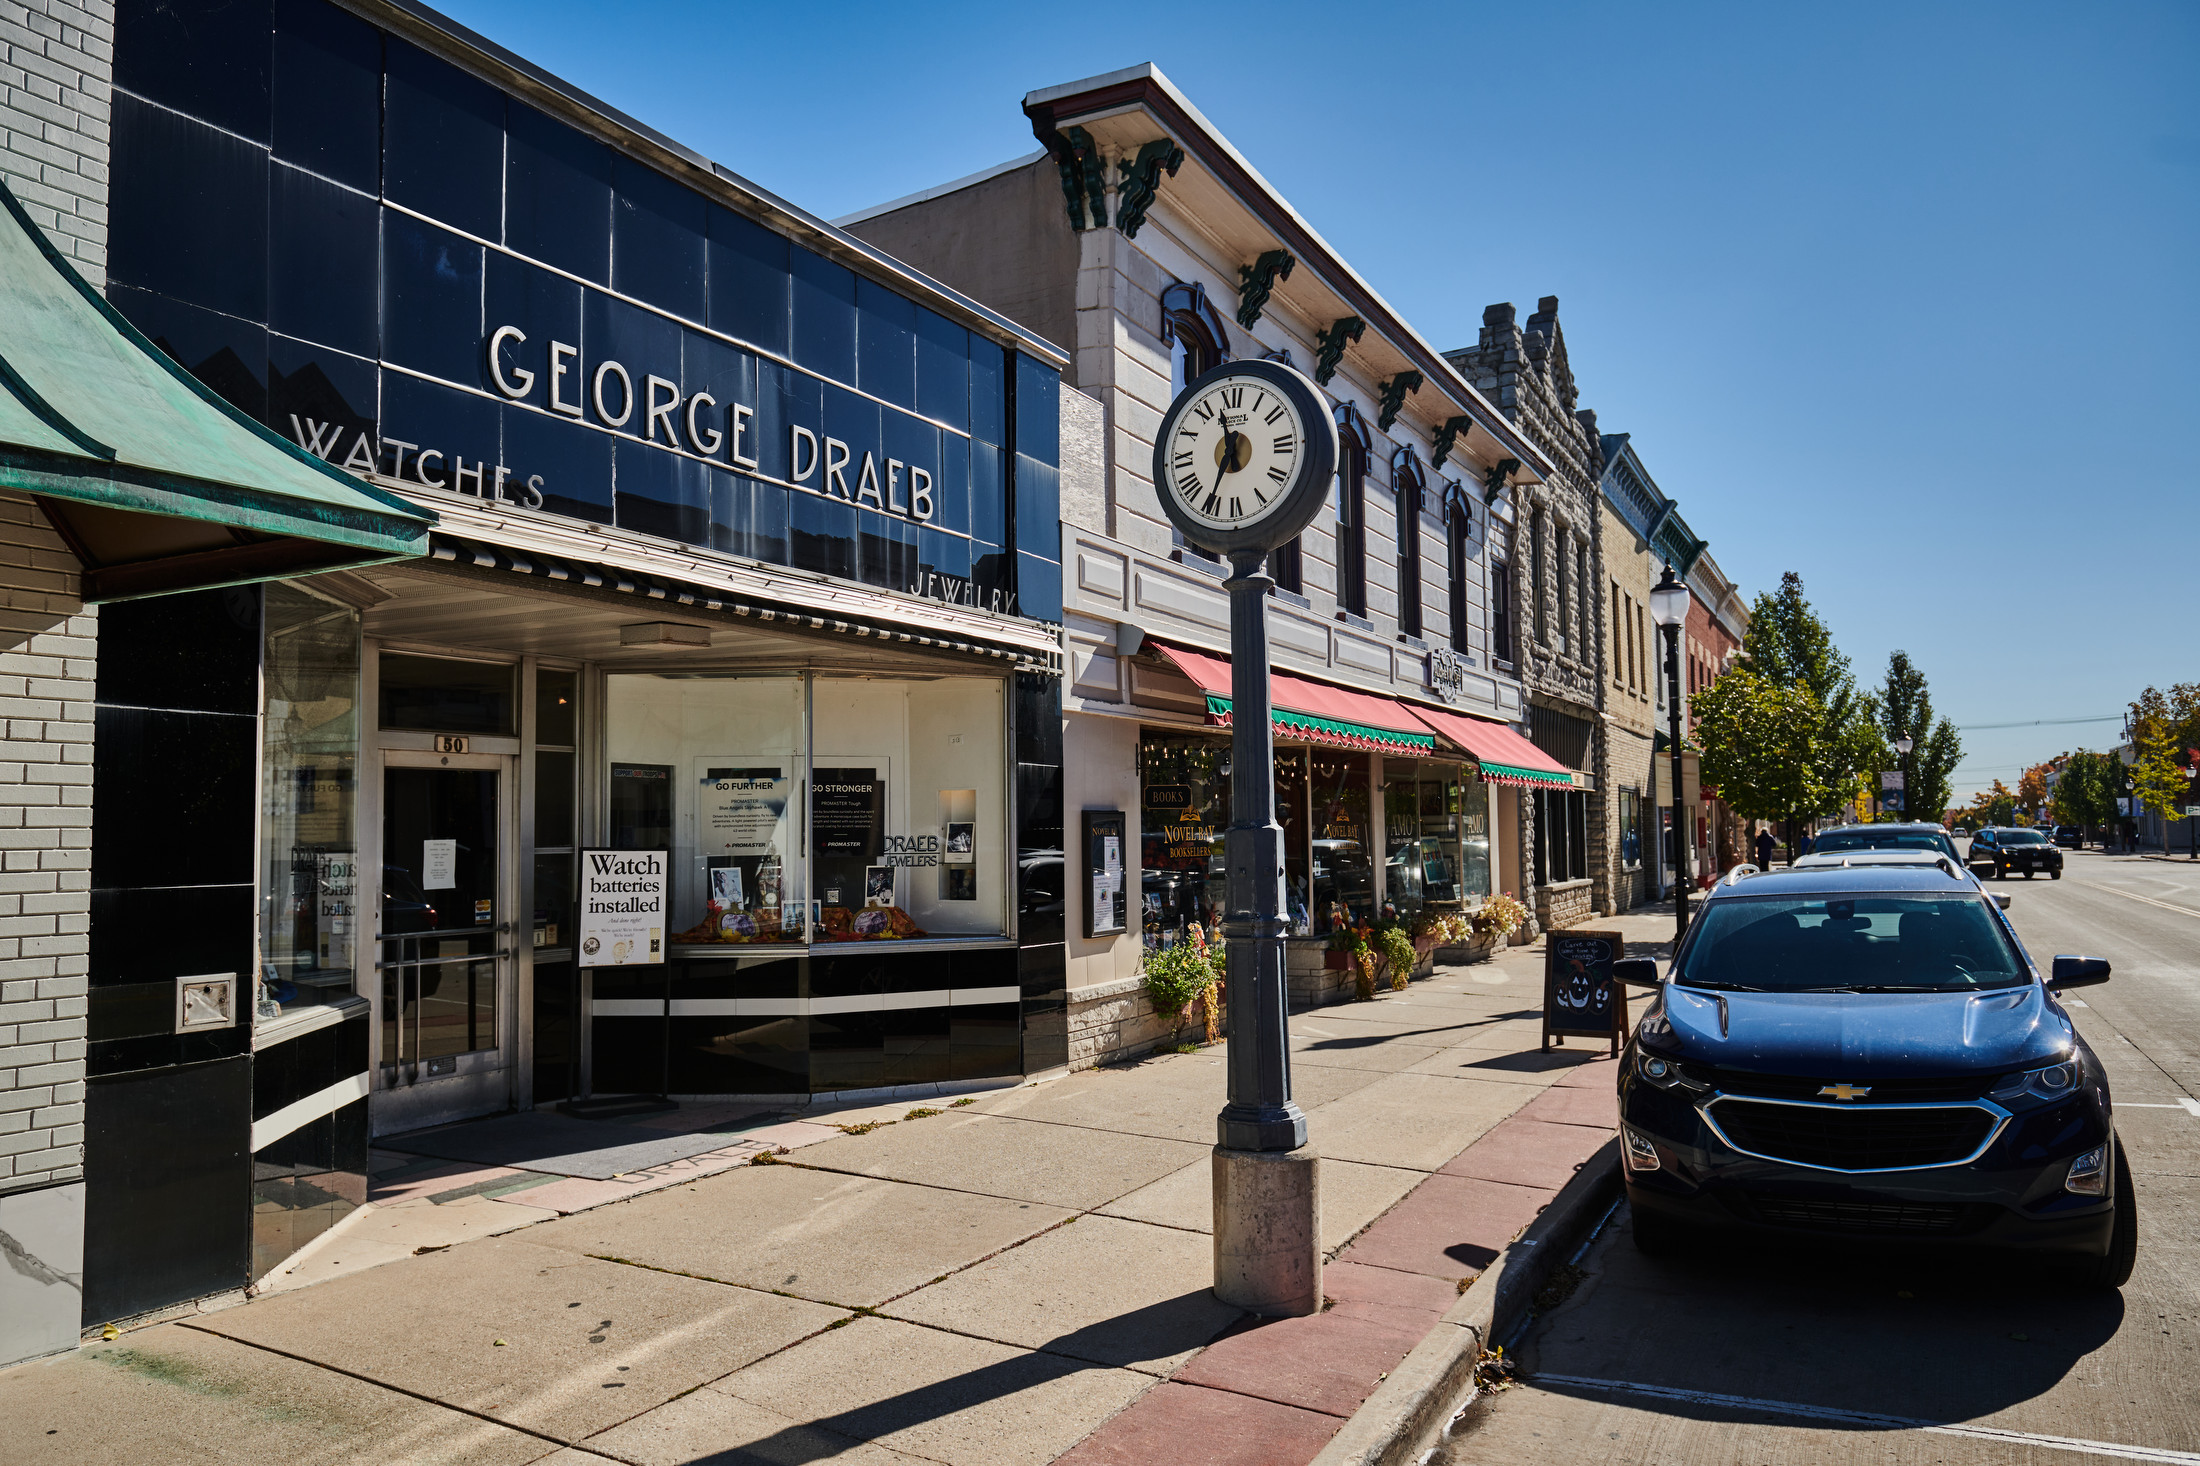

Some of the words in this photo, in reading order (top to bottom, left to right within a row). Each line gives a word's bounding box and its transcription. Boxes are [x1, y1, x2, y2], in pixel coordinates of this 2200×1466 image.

[1221, 388, 1243, 410] XII
[1194, 400, 1214, 425] XI
[1264, 405, 1285, 426] II
[489, 325, 758, 470] GEORGE
[790, 424, 934, 520] DRAEB
[1180, 427, 1198, 442] X
[1274, 434, 1293, 454] III
[290, 413, 545, 510] WATCHES
[1175, 451, 1193, 469] IX
[1178, 472, 1203, 503] VIII
[1254, 488, 1267, 507] V
[1230, 497, 1243, 518] VI
[911, 572, 1016, 616] JEWELRY
[443, 737, 463, 752] 50
[716, 783, 729, 791] GO
[732, 782, 773, 790] FURTHER
[825, 785, 873, 793] STRONGER
[1153, 792, 1184, 802] BOOKS
[1164, 826, 1197, 844] NOVEL
[1198, 825, 1216, 841] BAY
[1326, 824, 1347, 839] NOVEL
[1348, 824, 1360, 839] BAY
[1391, 814, 1413, 836] AMO
[882, 835, 940, 852] DRAEB
[1170, 846, 1212, 858] BOOKSELLERS
[590, 854, 661, 875] Watch
[885, 856, 937, 867] JEWELERS
[590, 877, 660, 893] batteries
[589, 897, 660, 913] installed
